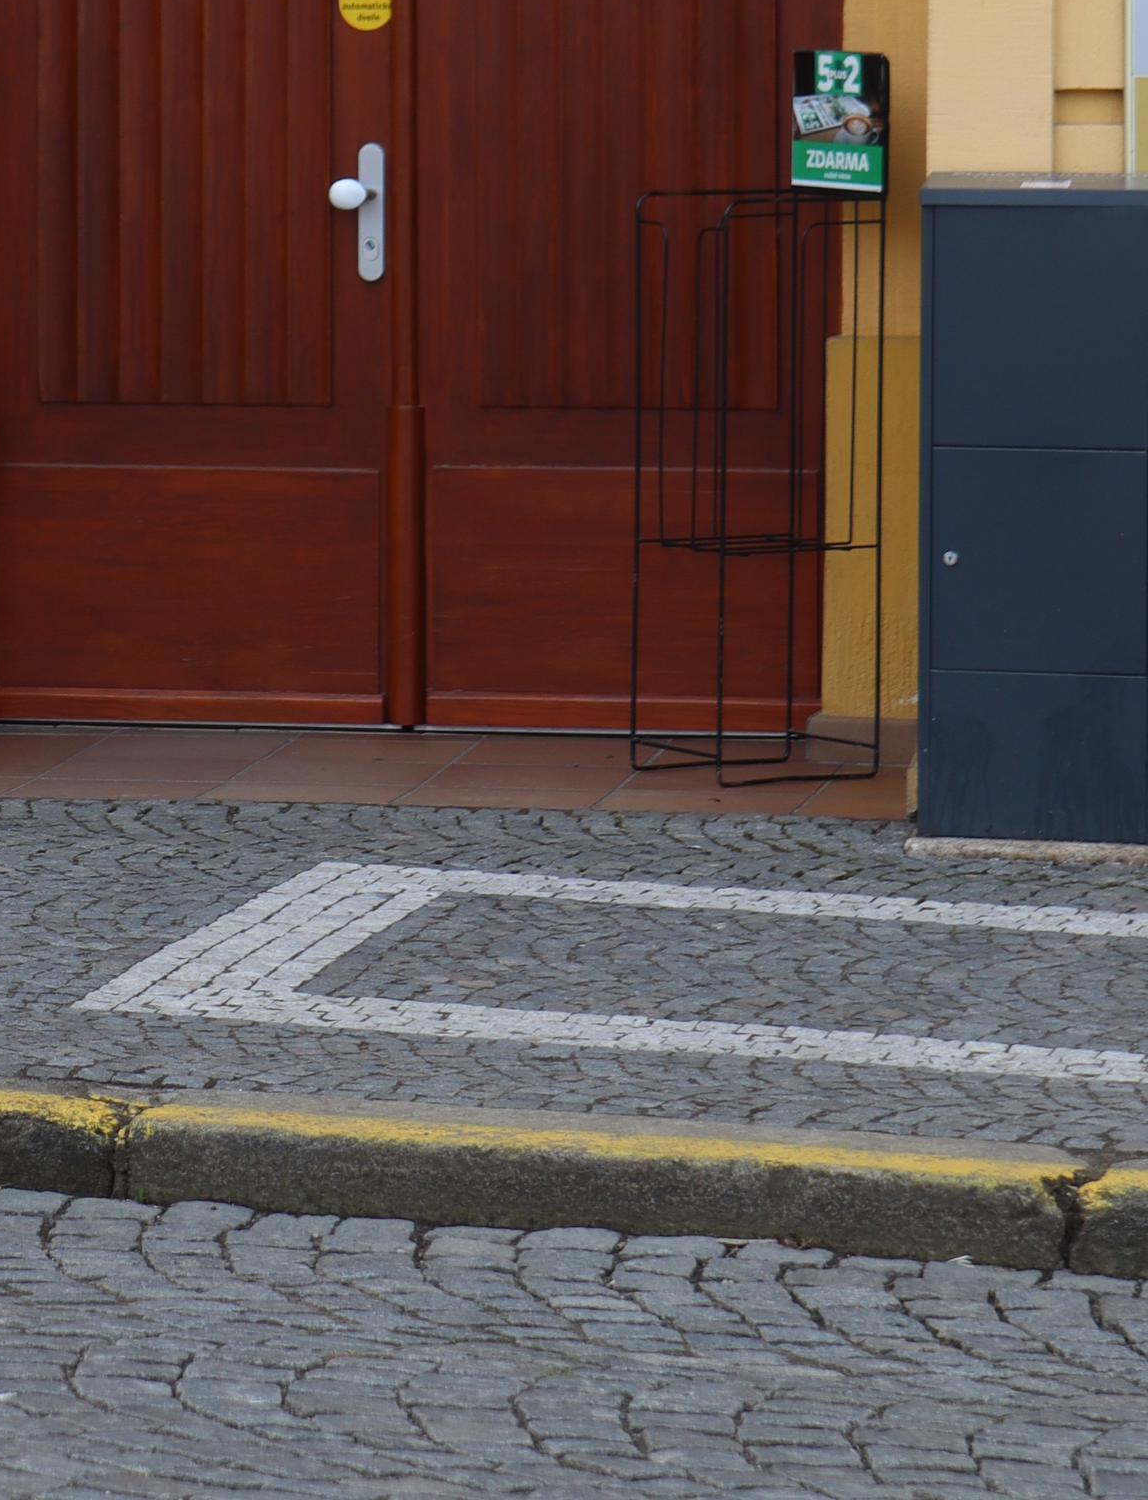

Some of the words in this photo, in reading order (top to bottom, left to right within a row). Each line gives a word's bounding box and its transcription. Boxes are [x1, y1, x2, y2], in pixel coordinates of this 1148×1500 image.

[817, 55, 834, 92] 5
[843, 56, 860, 94] 2
[806, 149, 870, 172] ZDARMA
